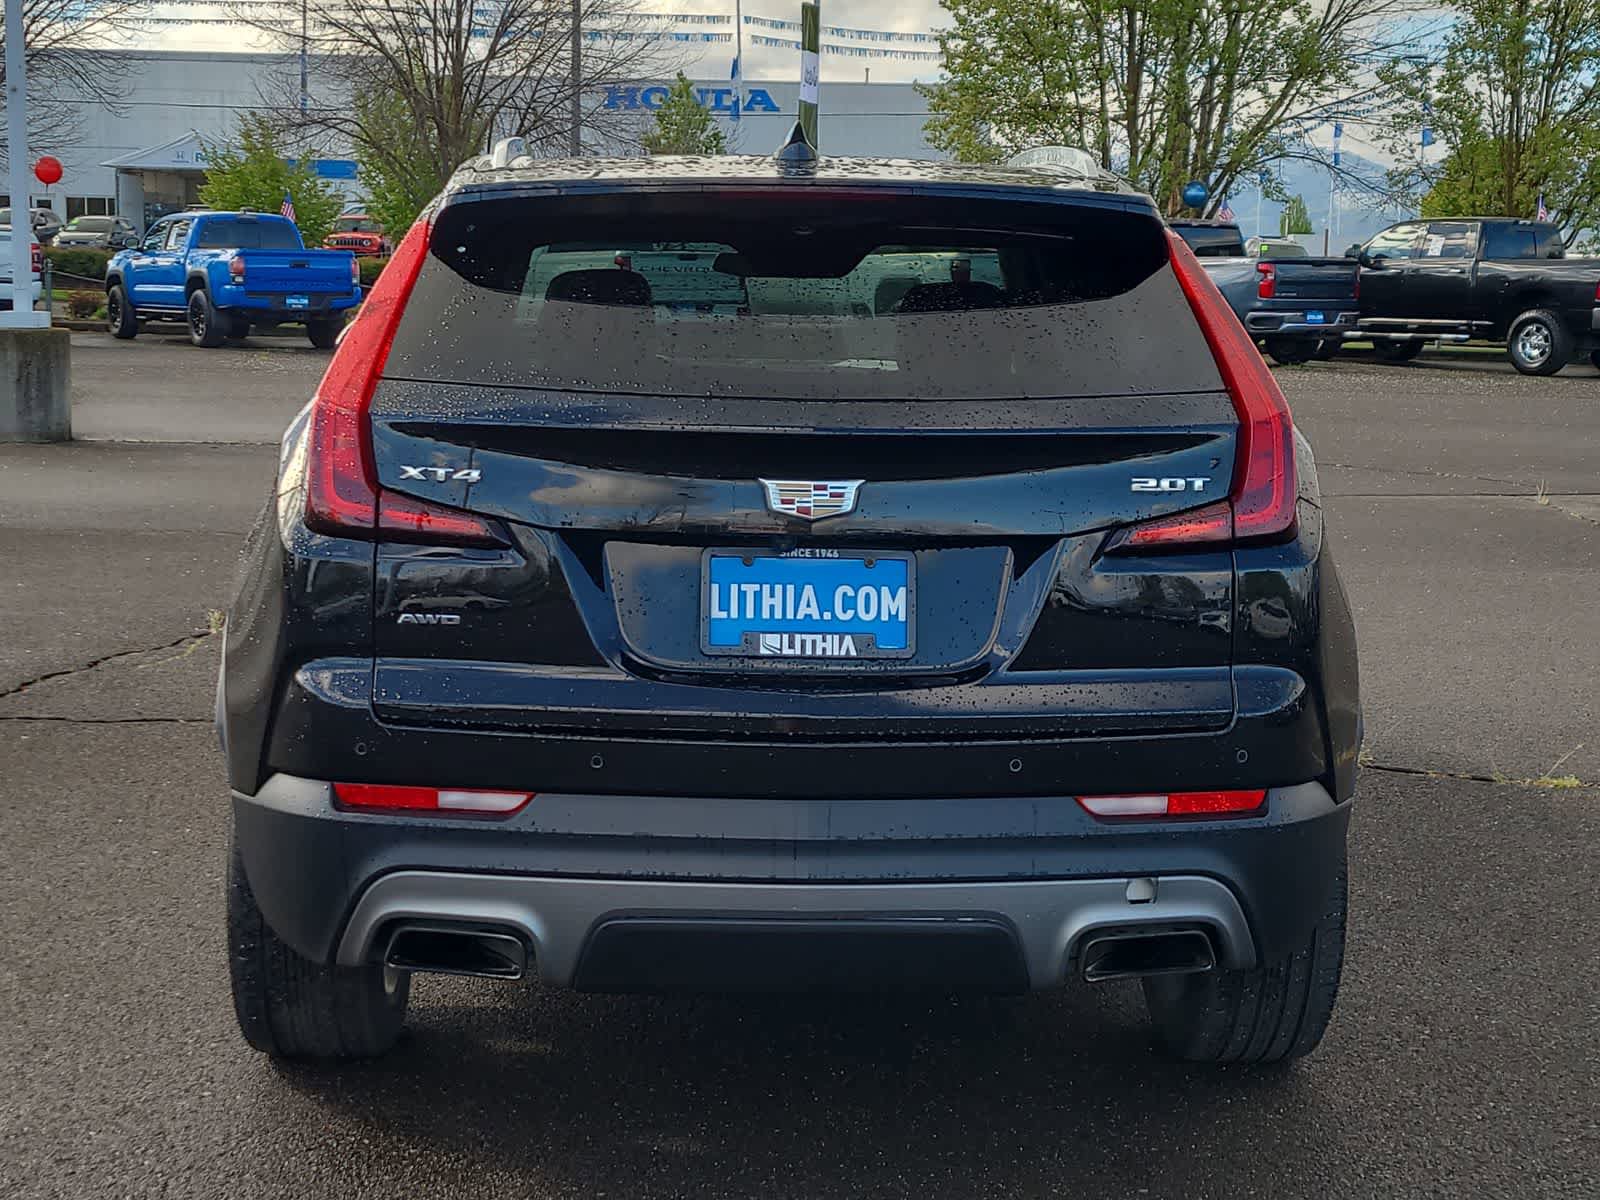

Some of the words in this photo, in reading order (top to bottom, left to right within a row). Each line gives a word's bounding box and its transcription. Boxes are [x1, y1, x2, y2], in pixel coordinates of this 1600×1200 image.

[640, 265, 710, 274] CHEVRO
[400, 465, 481, 483] XT4
[711, 583, 907, 622] LITHIA.COM
[397, 613, 461, 625] AWD
[783, 633, 857, 656] LITHIA
